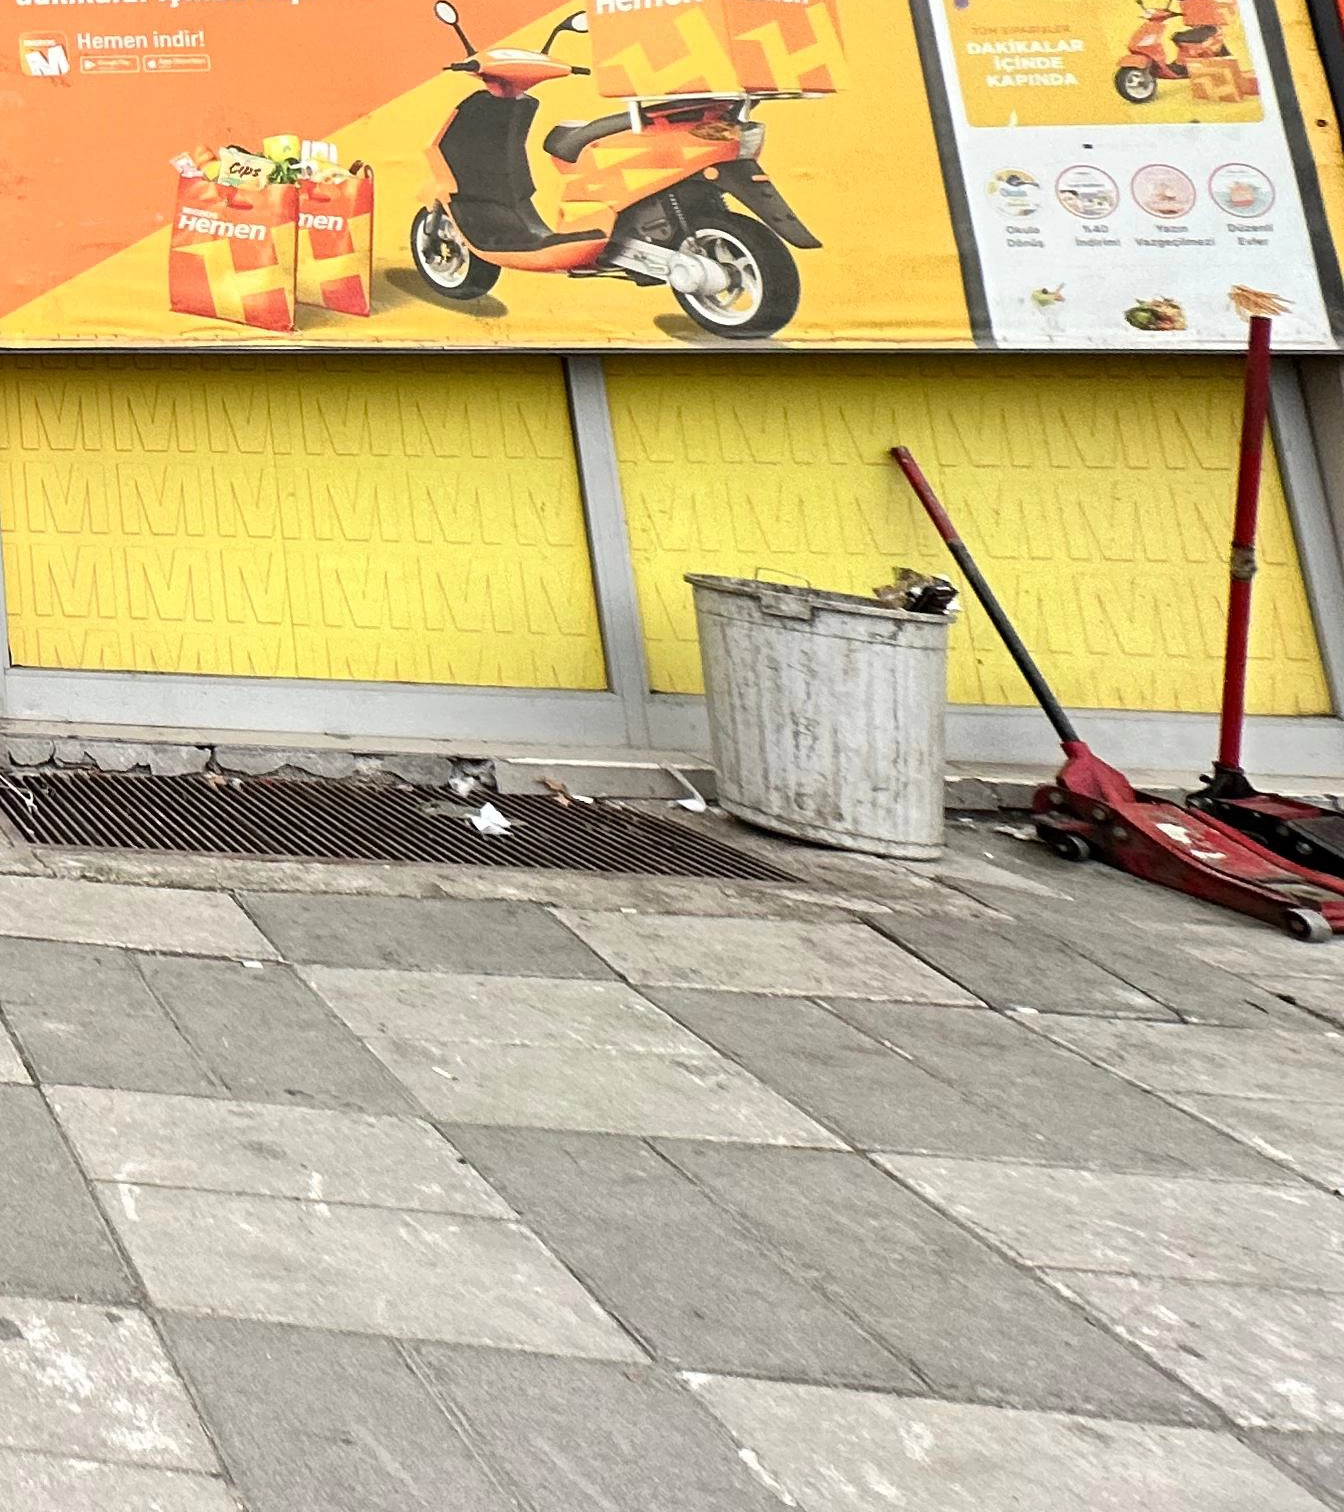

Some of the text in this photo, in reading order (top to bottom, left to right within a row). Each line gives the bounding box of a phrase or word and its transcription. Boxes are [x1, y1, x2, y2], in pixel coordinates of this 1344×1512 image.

[77, 32, 148, 50] Hemen
[153, 30, 205, 48] indir!
[967, 39, 1085, 55] DAKİKALAR
[986, 73, 1079, 87] KAPINDA
[178, 213, 266, 241] Hemen
